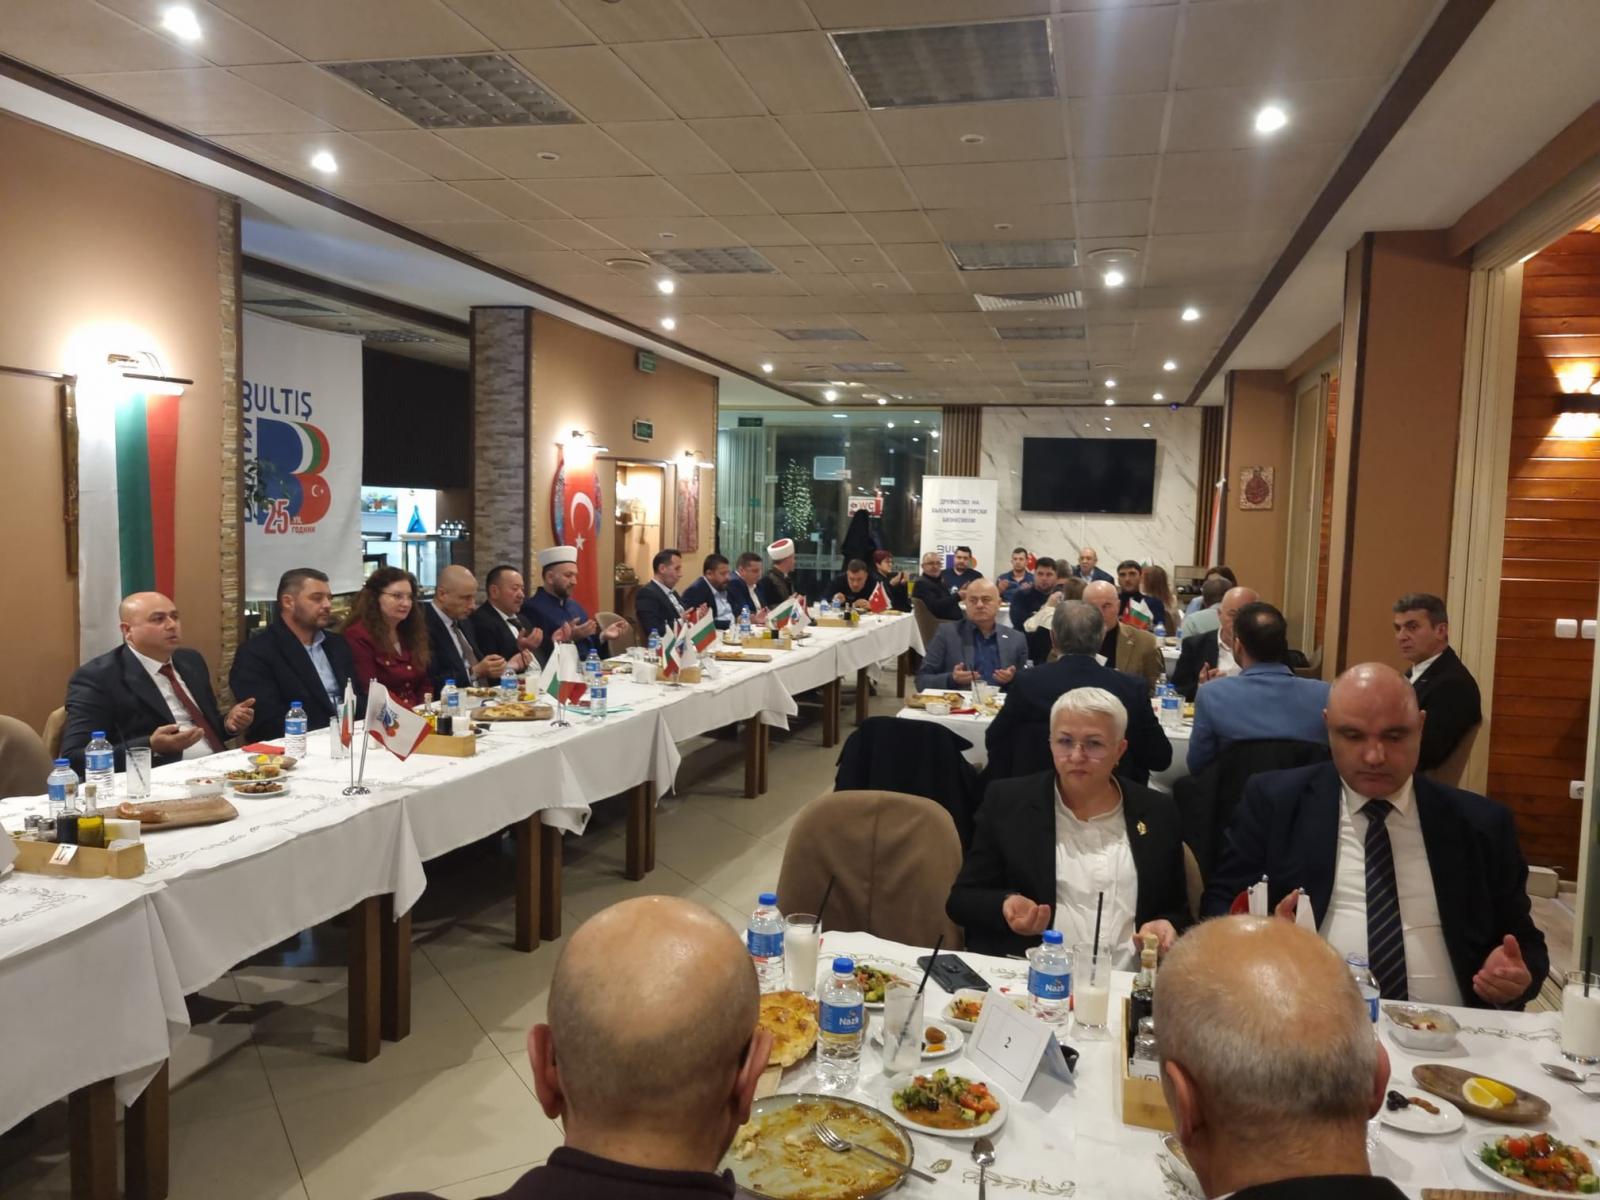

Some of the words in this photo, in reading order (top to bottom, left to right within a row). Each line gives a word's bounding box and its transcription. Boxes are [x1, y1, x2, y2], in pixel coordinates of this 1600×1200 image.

[859, 500, 874, 511] WC
[265, 500, 289, 534] 25
[1003, 1036, 1012, 1049] 2
